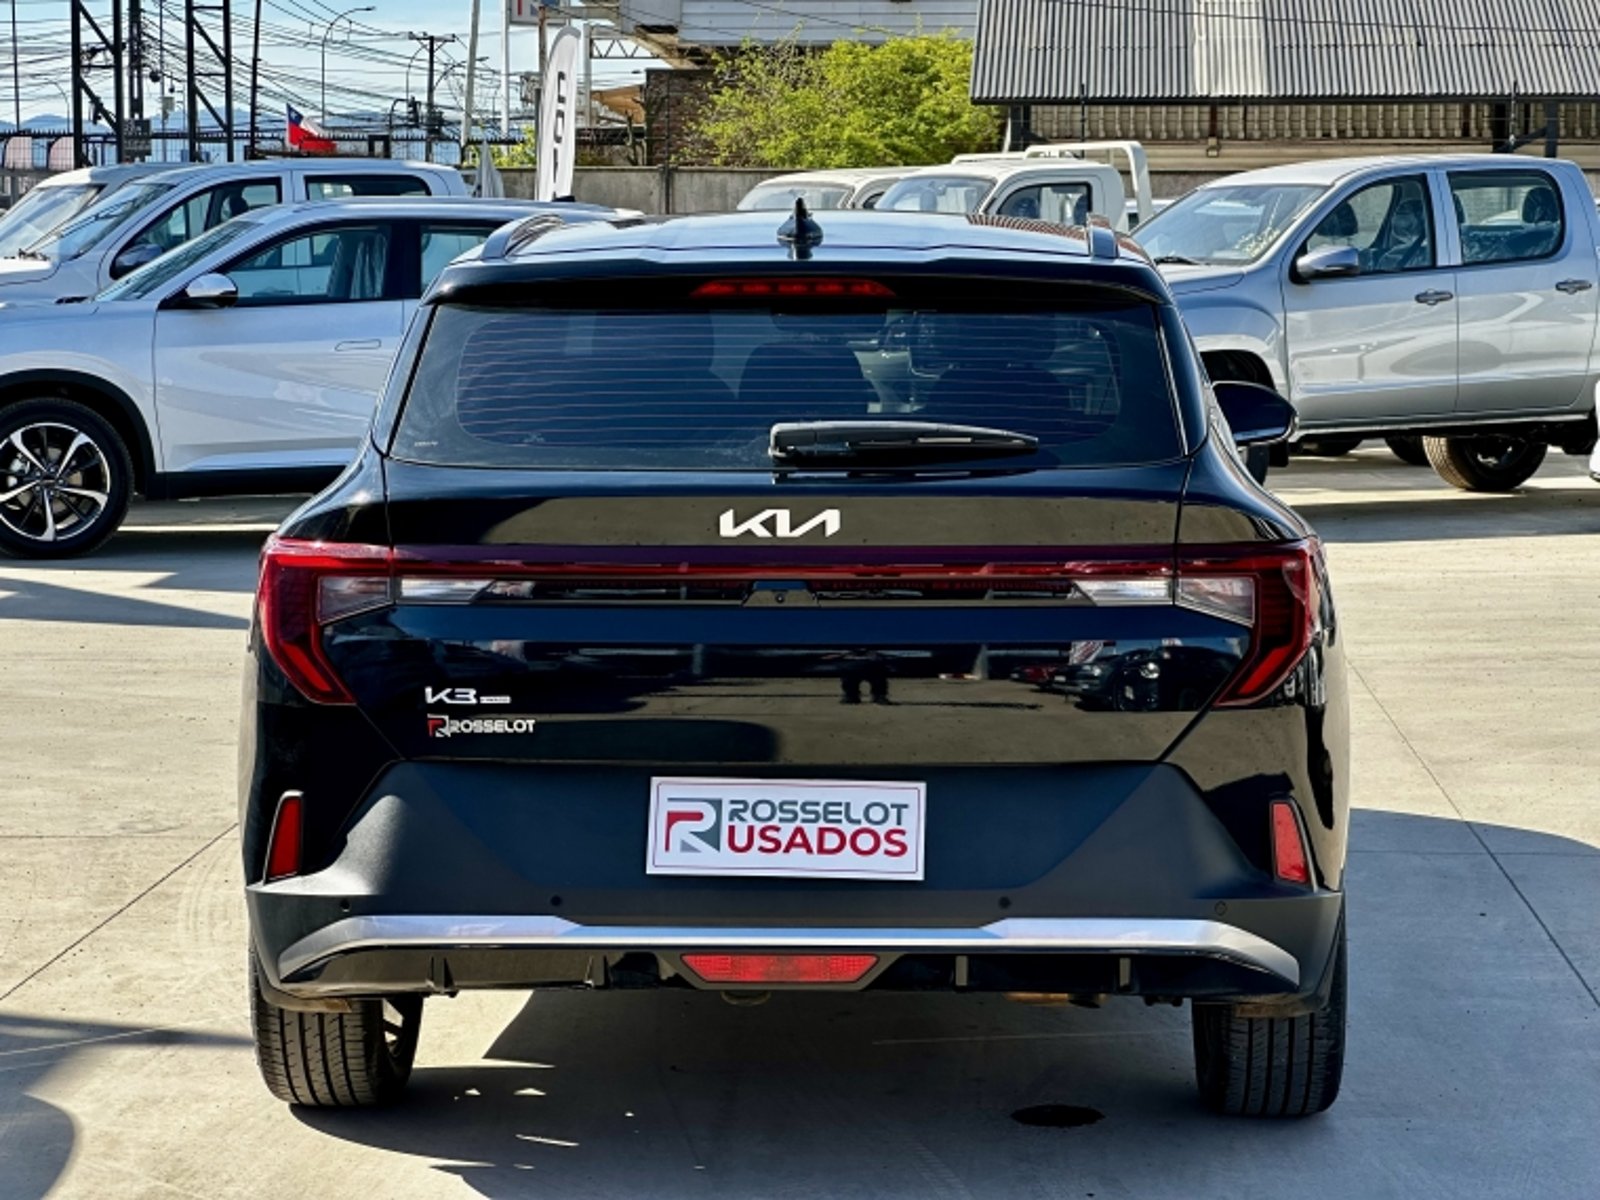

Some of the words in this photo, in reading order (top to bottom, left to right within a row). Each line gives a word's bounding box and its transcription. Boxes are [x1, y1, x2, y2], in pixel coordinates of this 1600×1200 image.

[720, 508, 840, 538] KIA
[424, 686, 478, 704] K3
[449, 719, 536, 733] ROSSELOT
[728, 799, 909, 826] ROSSELOT
[727, 824, 909, 857] USADOS
